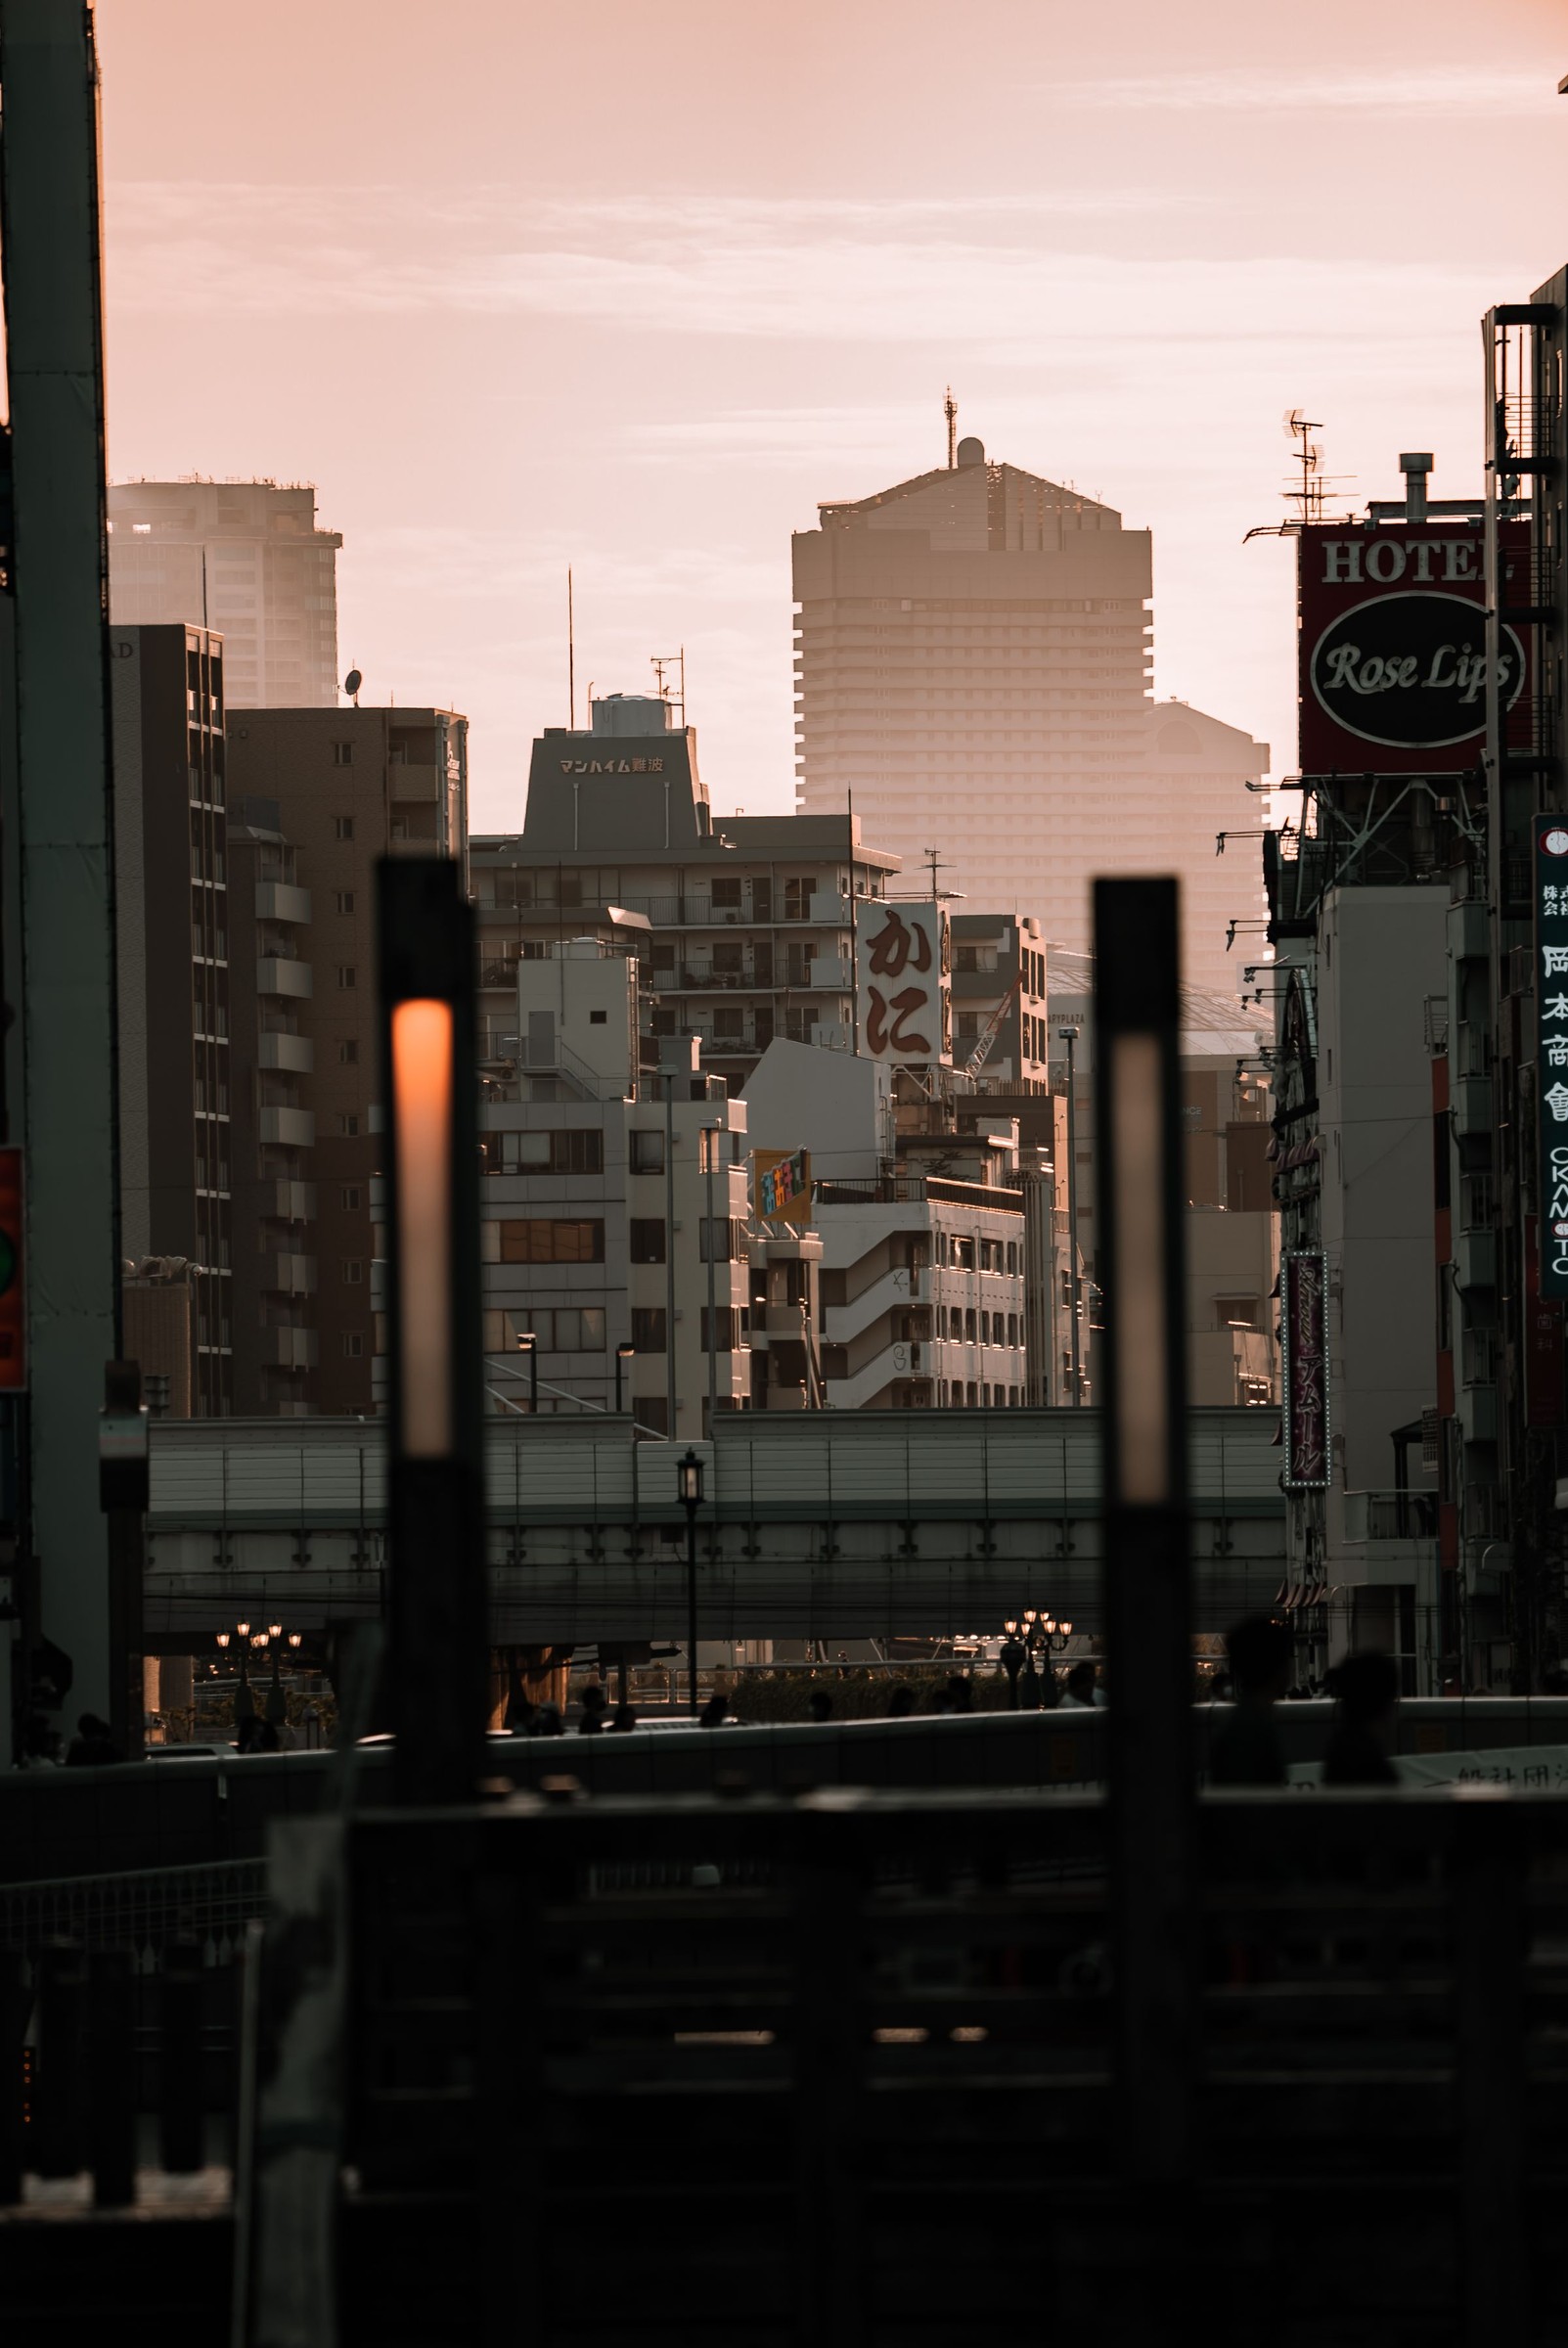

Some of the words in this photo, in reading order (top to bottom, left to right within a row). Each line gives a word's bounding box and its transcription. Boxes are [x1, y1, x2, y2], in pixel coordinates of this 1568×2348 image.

[1323, 642, 1418, 695] Rose
[560, 756, 664, 774] マンハイム難波
[866, 909, 932, 1055] かに
[1294, 1356, 1322, 1472] アムール
